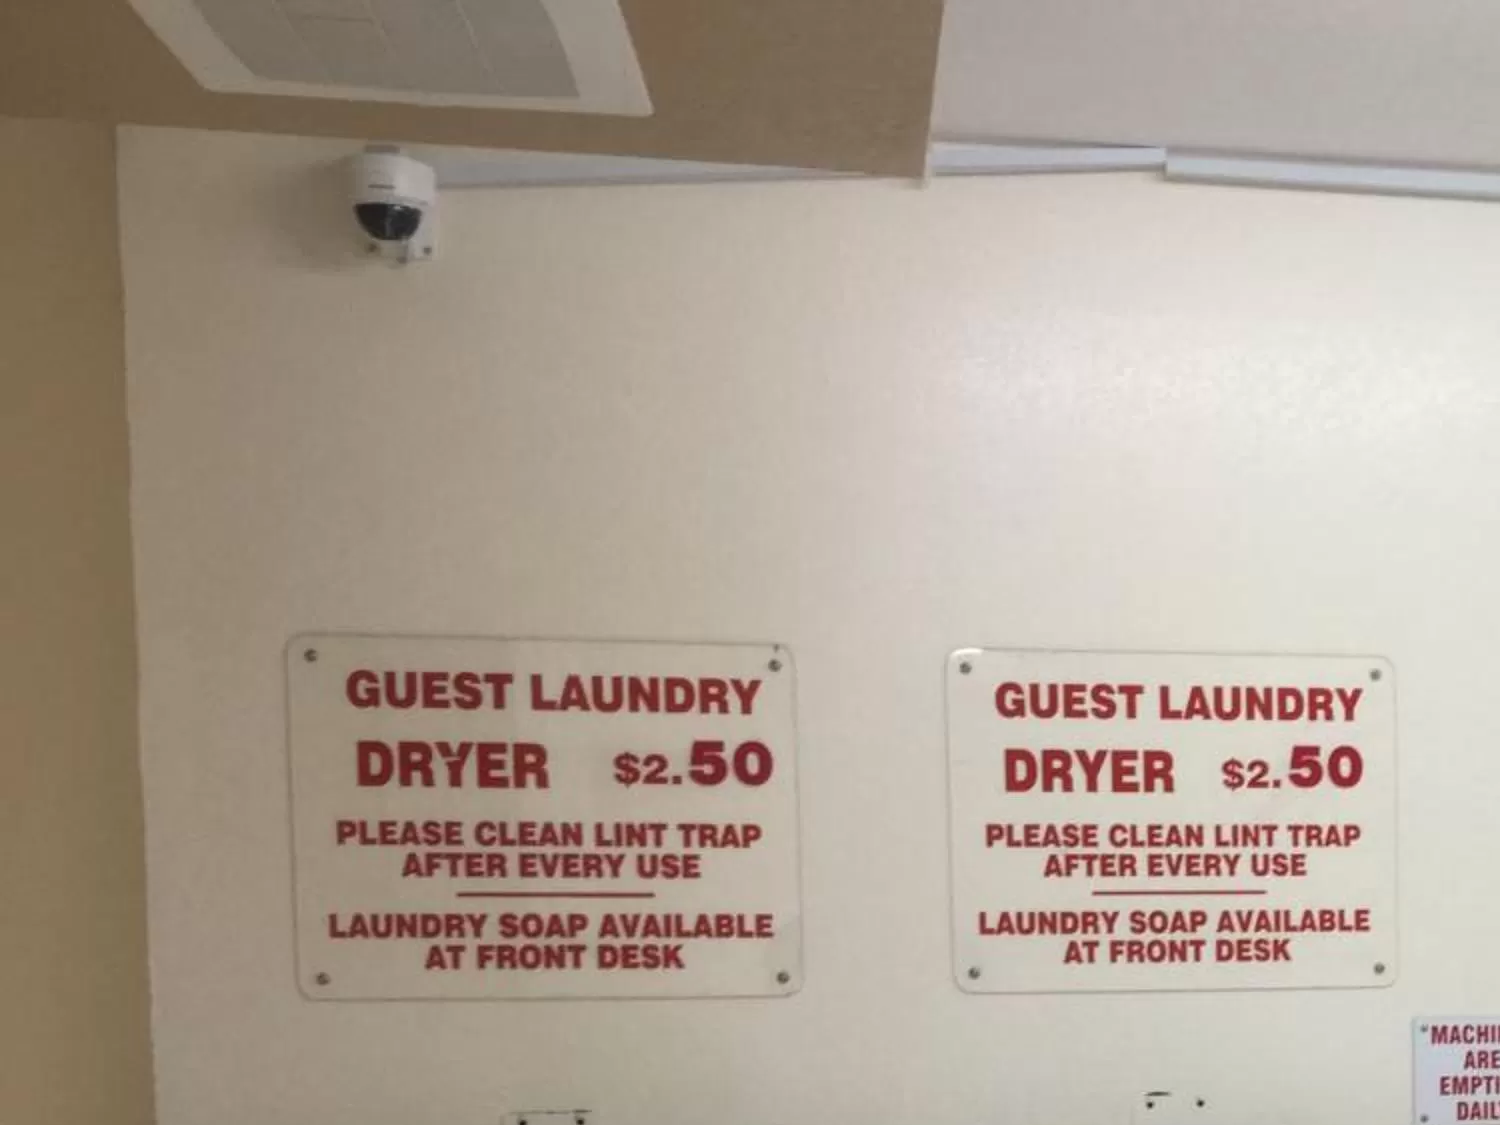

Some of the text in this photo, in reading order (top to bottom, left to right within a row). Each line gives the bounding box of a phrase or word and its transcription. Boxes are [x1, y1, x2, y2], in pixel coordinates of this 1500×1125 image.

[345, 669, 762, 715] GUEST LAUNDRY
[994, 681, 1363, 722] GUEST LAUNDRY
[356, 739, 774, 789] DRYER $2.50
[1004, 745, 1364, 793] DRYER $2.50
[335, 819, 762, 849] PLEASE CLEAN LINT TRAP
[985, 823, 1361, 849] PLEASE CLEAN LINT TRAP
[401, 851, 701, 880] AFTER EVERY USE
[1043, 852, 1307, 878] AFTER EVERY USE
[328, 912, 773, 940] LAUNDRY SOAP AVAILABLE
[978, 908, 1371, 936] LAUNDRY SOAP AVAILABLE
[424, 943, 685, 970] AT FRONT DESK
[1063, 938, 1291, 965] AT FRONT DESK
[1463, 1049, 1500, 1070] ARE
